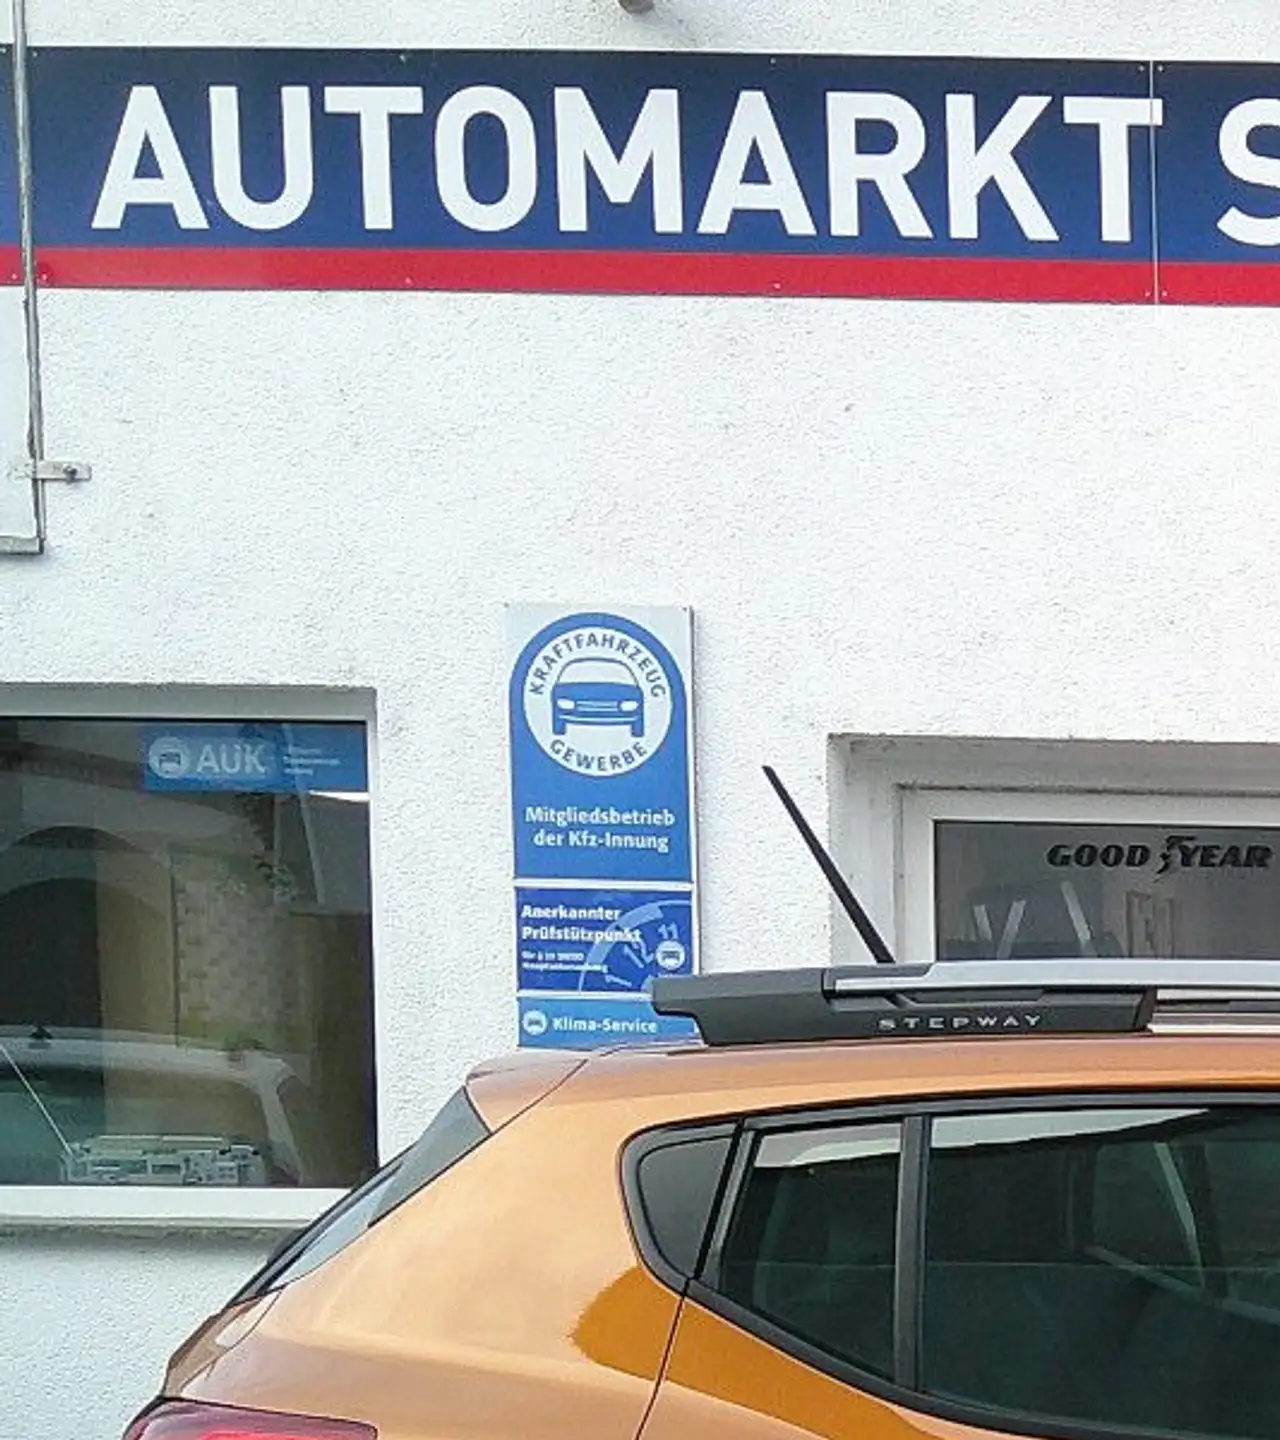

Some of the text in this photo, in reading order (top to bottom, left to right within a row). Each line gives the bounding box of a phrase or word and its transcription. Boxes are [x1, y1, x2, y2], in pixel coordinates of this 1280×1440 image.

[91, 83, 1164, 243] AUTOMARKT
[528, 632, 667, 698] KRAFTFAHRZEUG
[550, 739, 648, 772] GEWERBE
[525, 806, 676, 828] Mitgliedsbetrieb
[533, 829, 669, 853] der Kfz-Innung
[521, 905, 622, 920] Anerkannter
[521, 926, 642, 943] Prüfstützpunkt
[552, 1017, 659, 1034] Klima-Service
[878, 1015, 1041, 1029] STEPWAY
